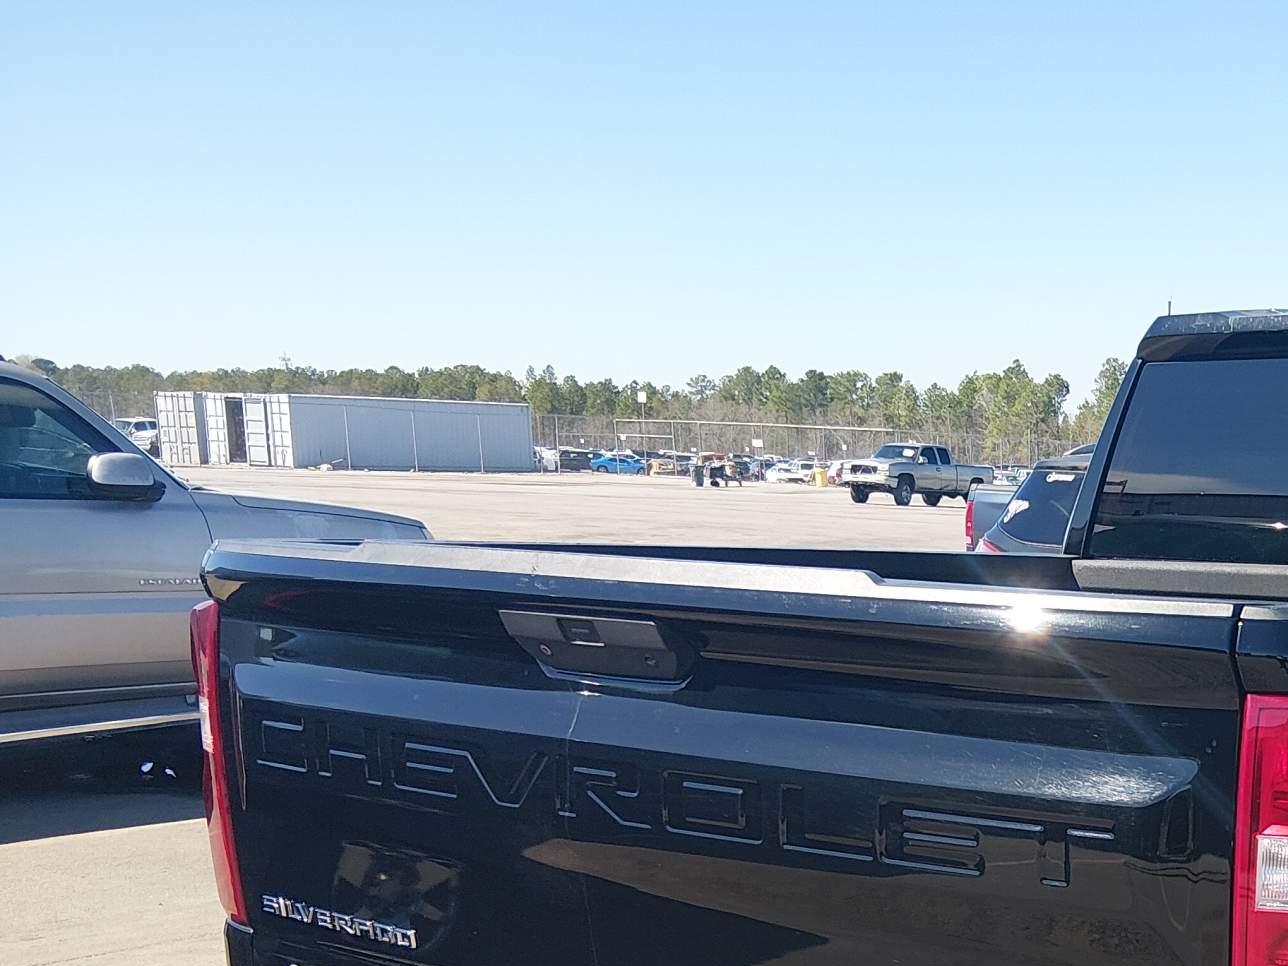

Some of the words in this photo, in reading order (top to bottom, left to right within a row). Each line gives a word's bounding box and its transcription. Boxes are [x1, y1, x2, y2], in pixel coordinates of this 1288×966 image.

[139, 577, 201, 585] ESCALAD
[257, 715, 1117, 889] CHEVROLET
[262, 894, 418, 950] SILVERADO
